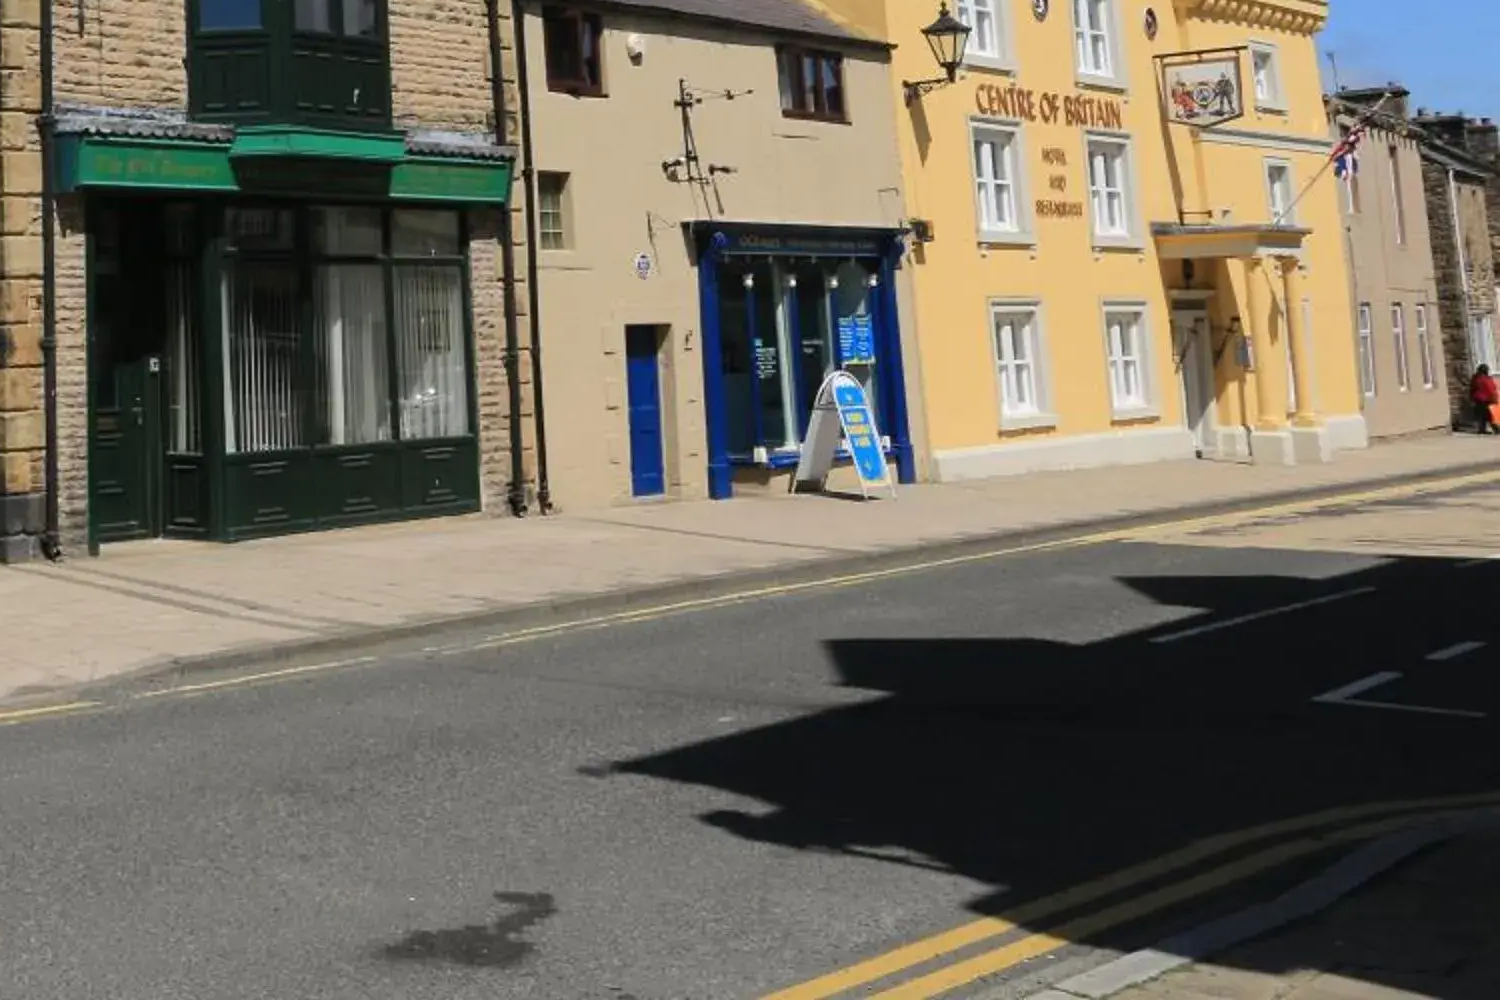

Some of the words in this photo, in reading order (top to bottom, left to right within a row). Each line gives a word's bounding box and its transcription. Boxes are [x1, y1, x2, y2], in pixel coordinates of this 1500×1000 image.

[976, 84, 1036, 121] CENTRE
[1039, 92, 1060, 125] OF
[1063, 95, 1122, 129] BRITAIN
